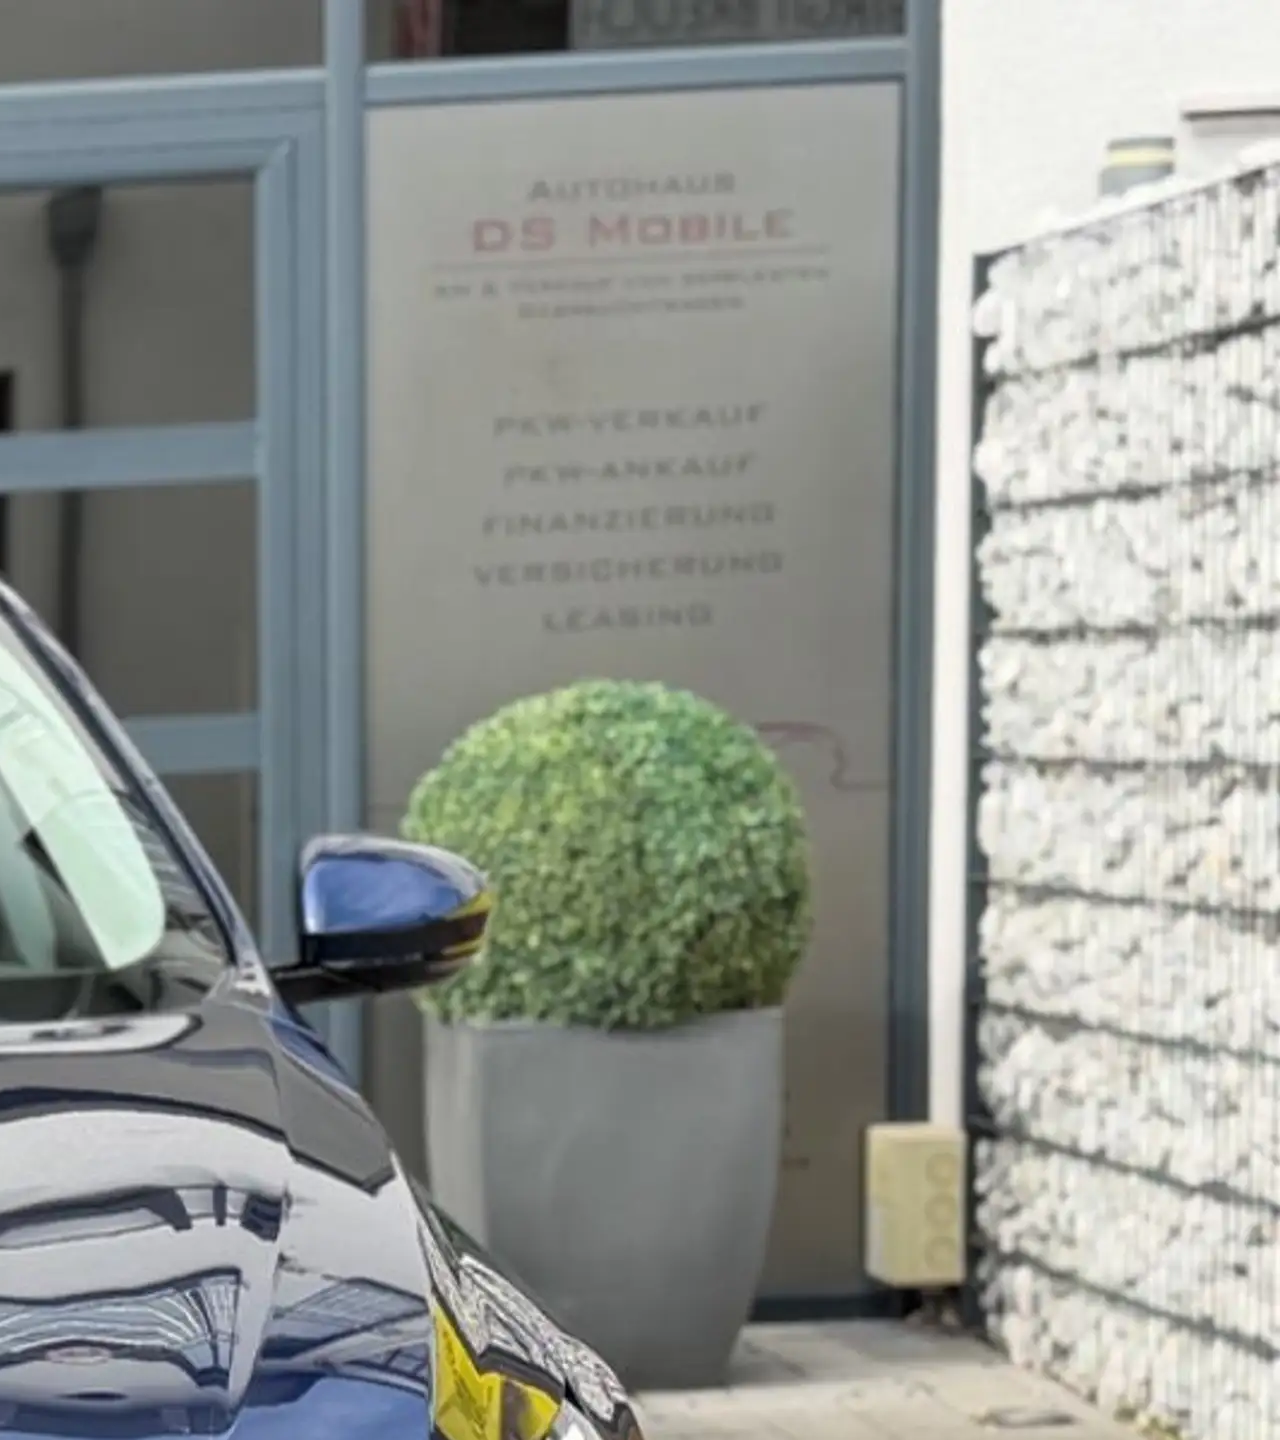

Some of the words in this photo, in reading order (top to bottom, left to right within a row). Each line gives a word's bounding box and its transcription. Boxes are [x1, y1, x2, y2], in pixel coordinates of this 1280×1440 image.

[526, 171, 736, 201] AUTOHAUS
[473, 216, 556, 252] DS
[589, 208, 795, 249] MOBILE
[493, 402, 766, 438] PKW-VERKAUF
[482, 501, 776, 536] FINANZIERUNG
[473, 551, 783, 588] VERSICHERUNG
[541, 601, 713, 634] LEASING
